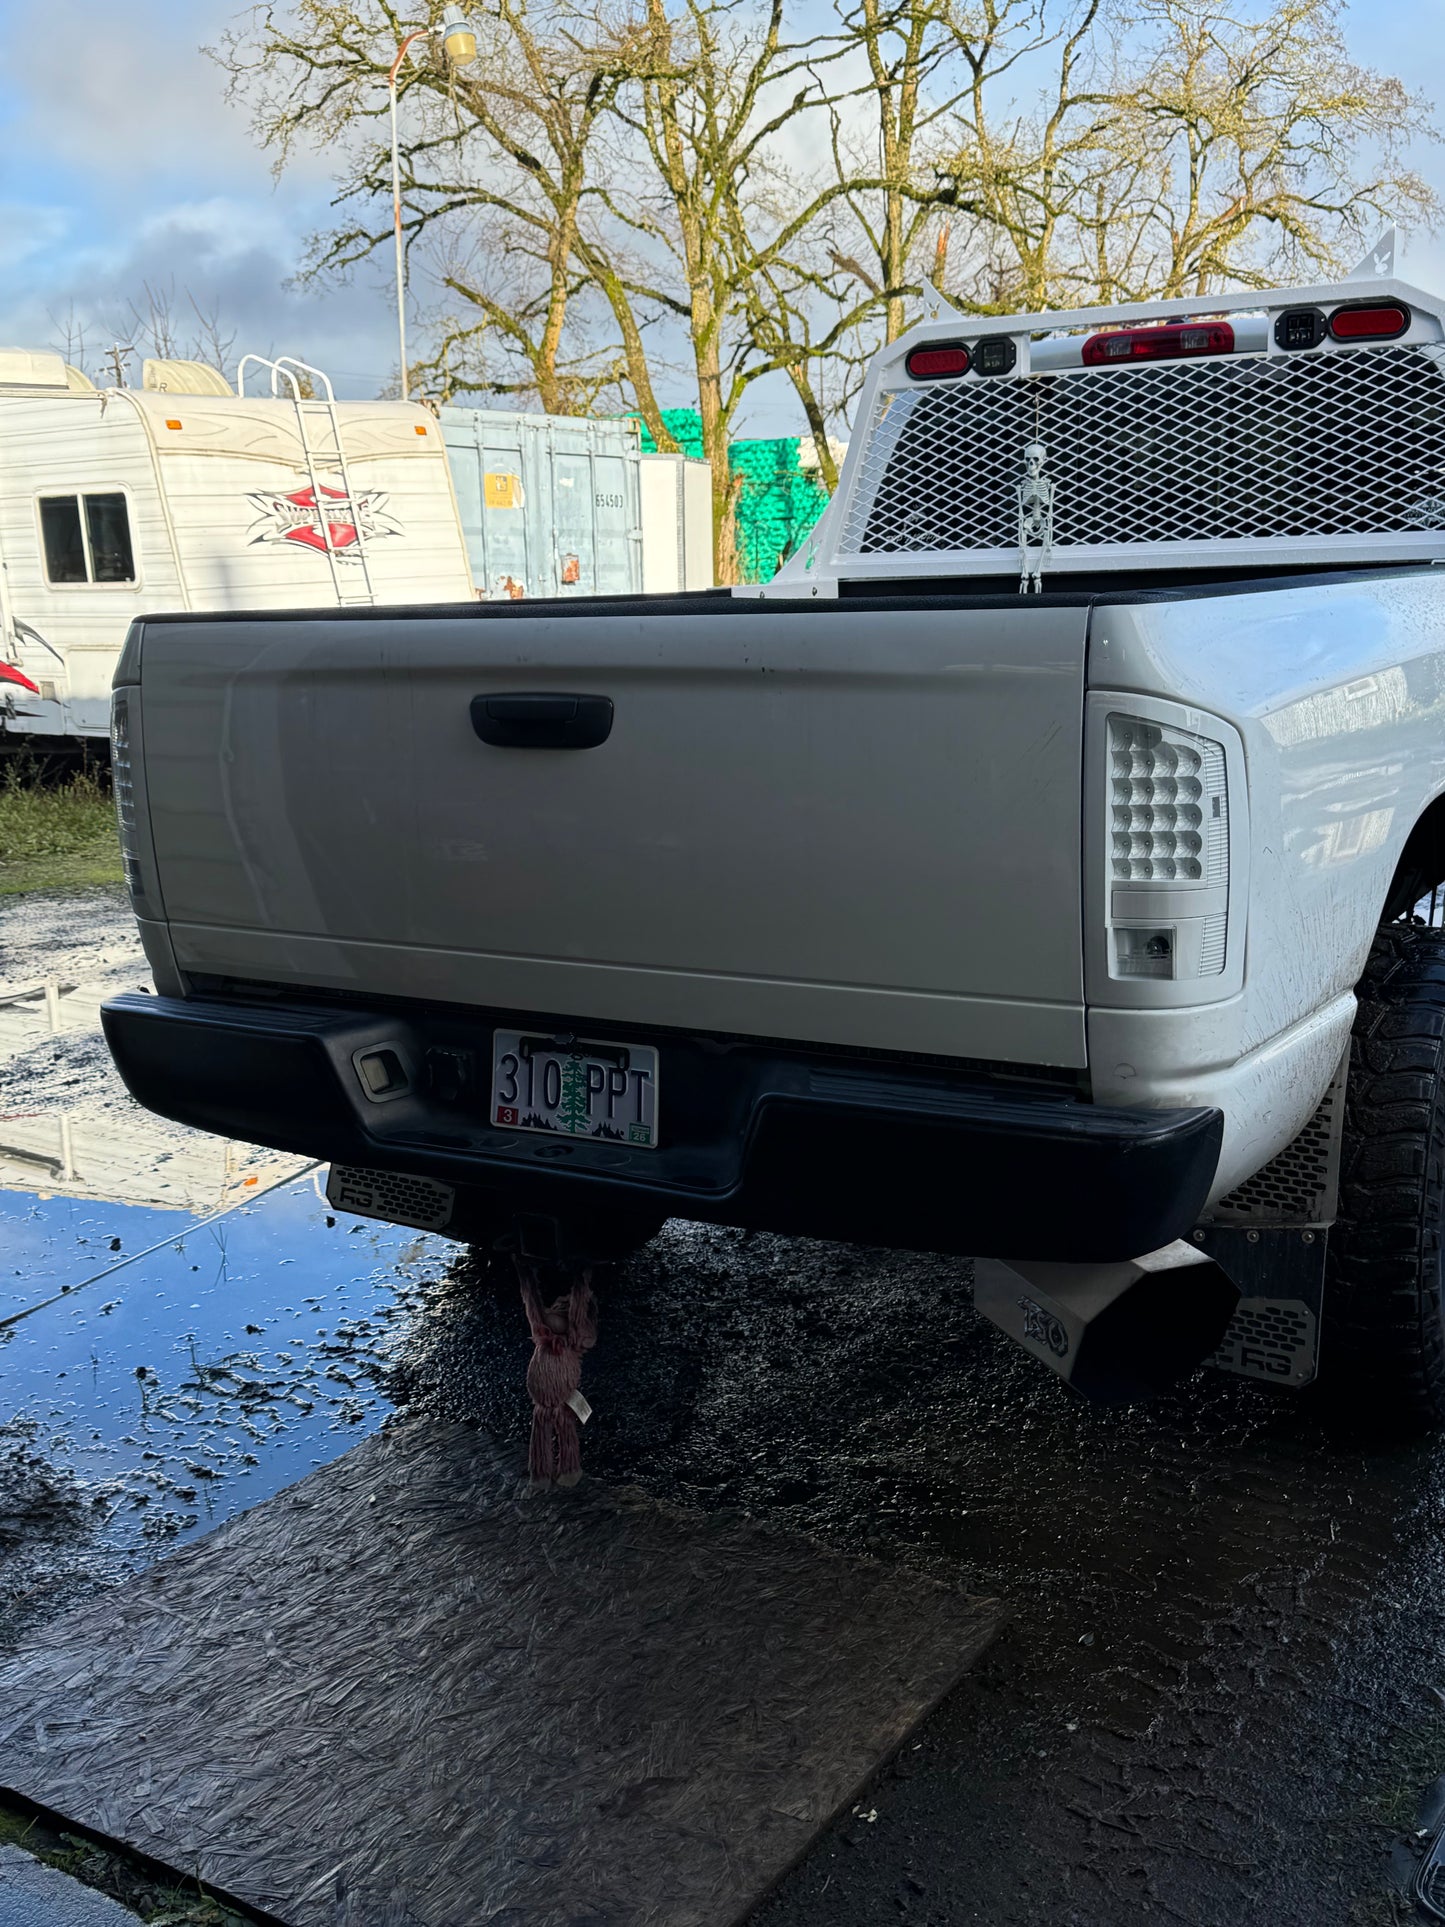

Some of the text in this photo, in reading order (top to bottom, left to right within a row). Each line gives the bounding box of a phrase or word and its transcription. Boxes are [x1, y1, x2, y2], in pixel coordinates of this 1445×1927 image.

[595, 493, 624, 509] 654503
[500, 1053, 650, 1122] 310 PPT
[503, 1109, 513, 1123] 3
